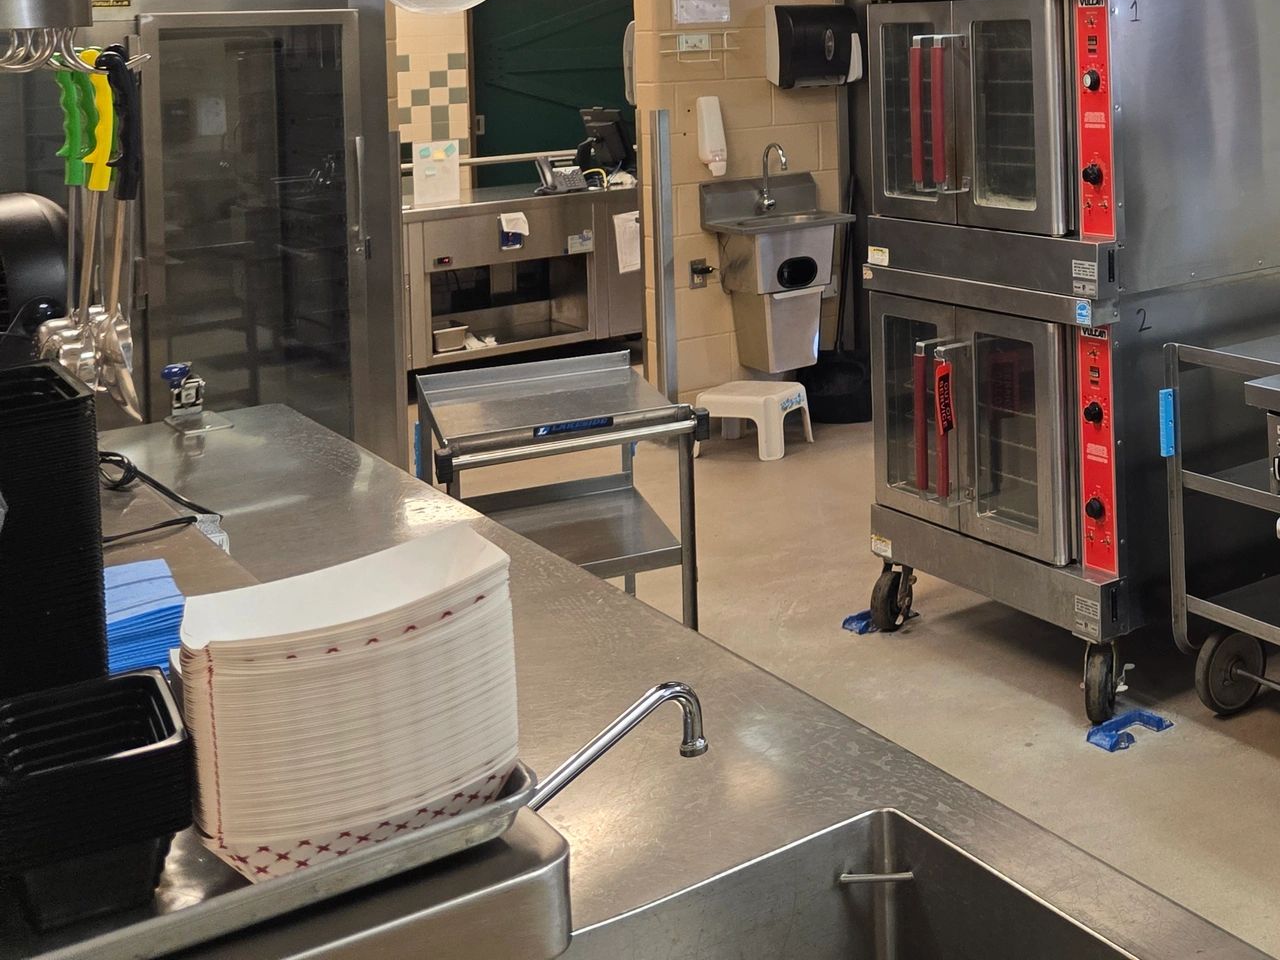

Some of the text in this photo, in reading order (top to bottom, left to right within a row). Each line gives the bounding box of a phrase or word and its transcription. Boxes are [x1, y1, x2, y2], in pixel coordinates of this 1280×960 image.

[1129, 0, 1141, 22] 1
[1136, 307, 1152, 333] 2
[1082, 326, 1106, 338] VULCAN
